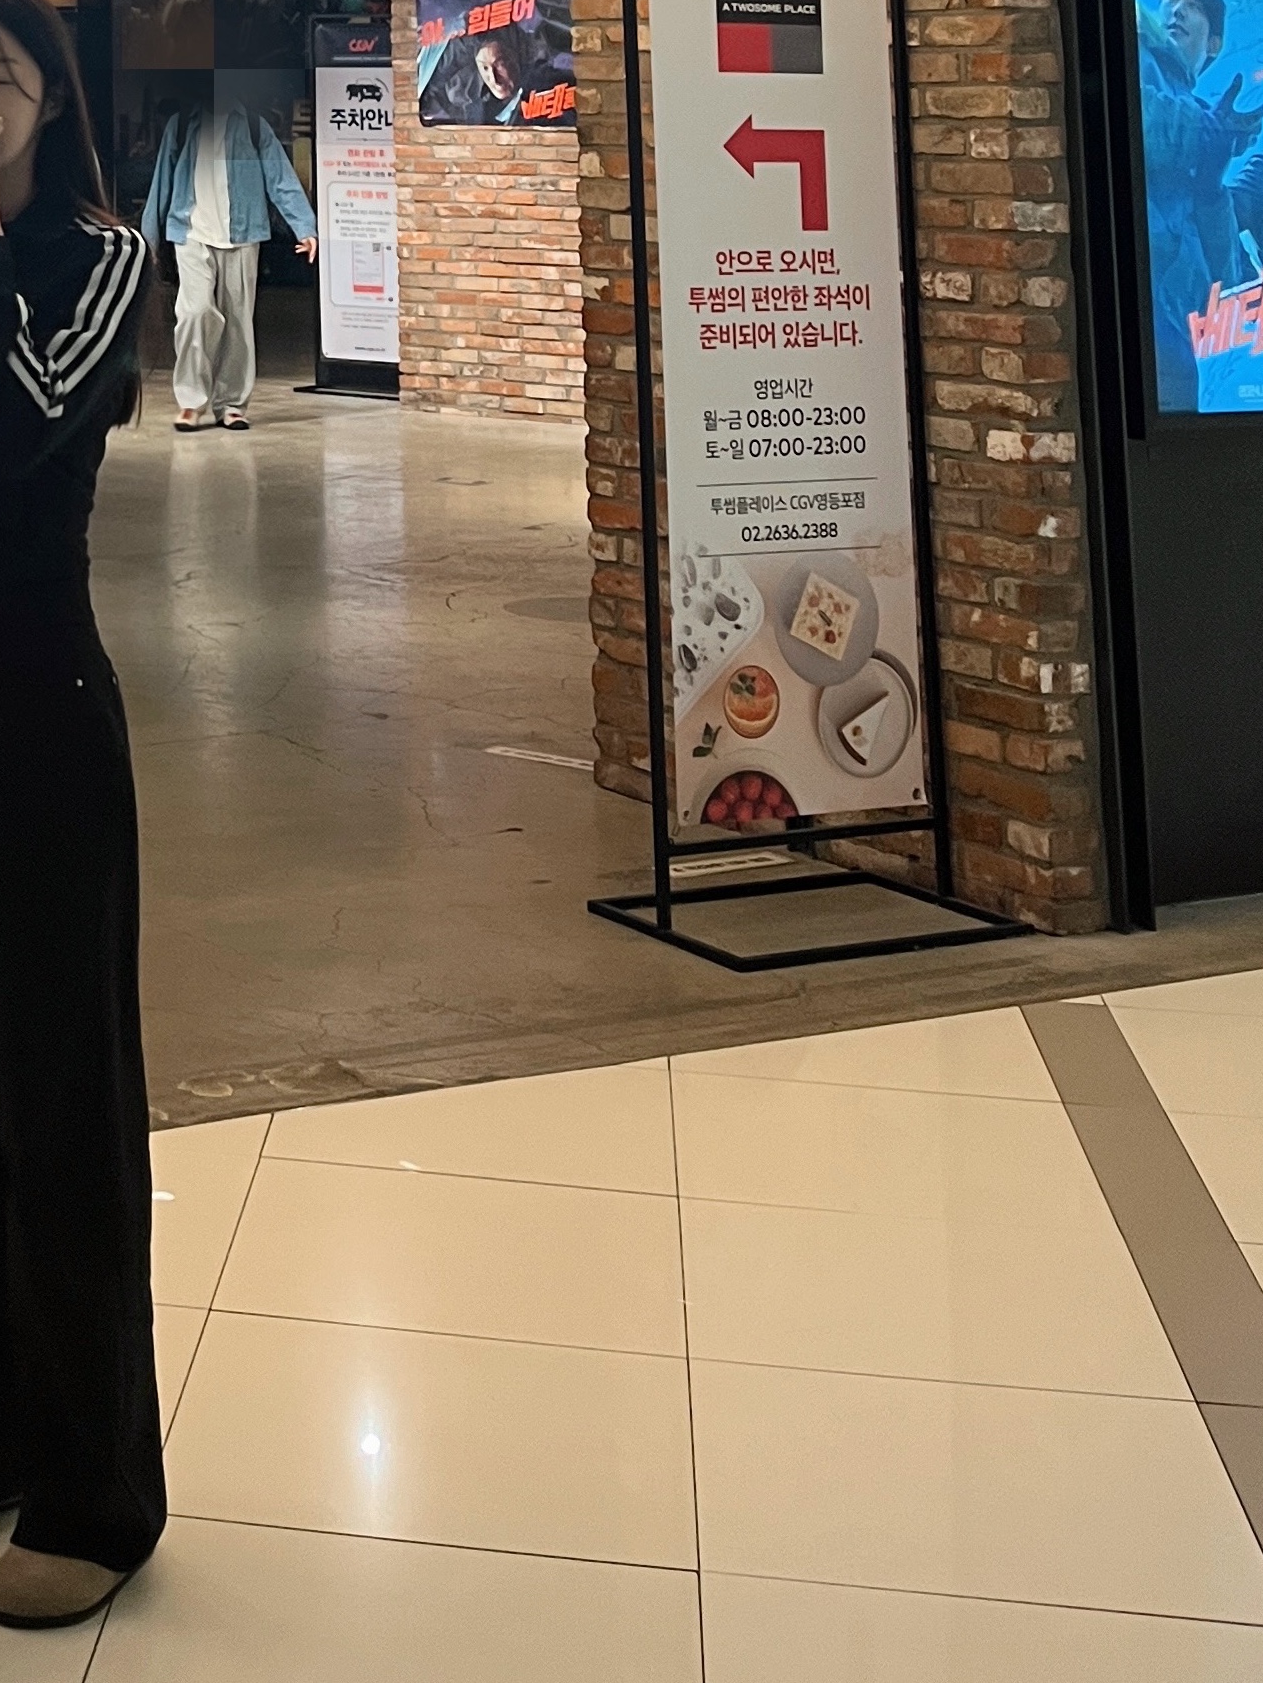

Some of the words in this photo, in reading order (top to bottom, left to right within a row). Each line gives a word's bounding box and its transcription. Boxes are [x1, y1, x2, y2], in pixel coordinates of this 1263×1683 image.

[722, 2, 730, 12] A
[731, 2, 783, 14] TWOSOME
[783, 4, 817, 15] PLACE
[715, 248, 775, 276] 안으로
[779, 248, 841, 276] 오시면,
[688, 285, 746, 314] 투썸의
[751, 284, 809, 313] 편안한
[813, 283, 871, 311] 좌석이
[699, 321, 776, 350] 준비되어
[782, 319, 864, 349] 있습니다.
[753, 377, 814, 400] 영업시간
[703, 409, 743, 432] 월~금
[746, 406, 866, 429] 08:00-23:00
[705, 437, 745, 461] 토~일
[748, 434, 866, 458] 07:00-23:00
[710, 494, 789, 516] 투썸플레이스
[789, 491, 866, 512] CGV영등포점
[741, 521, 839, 543] 02.2636.2388
